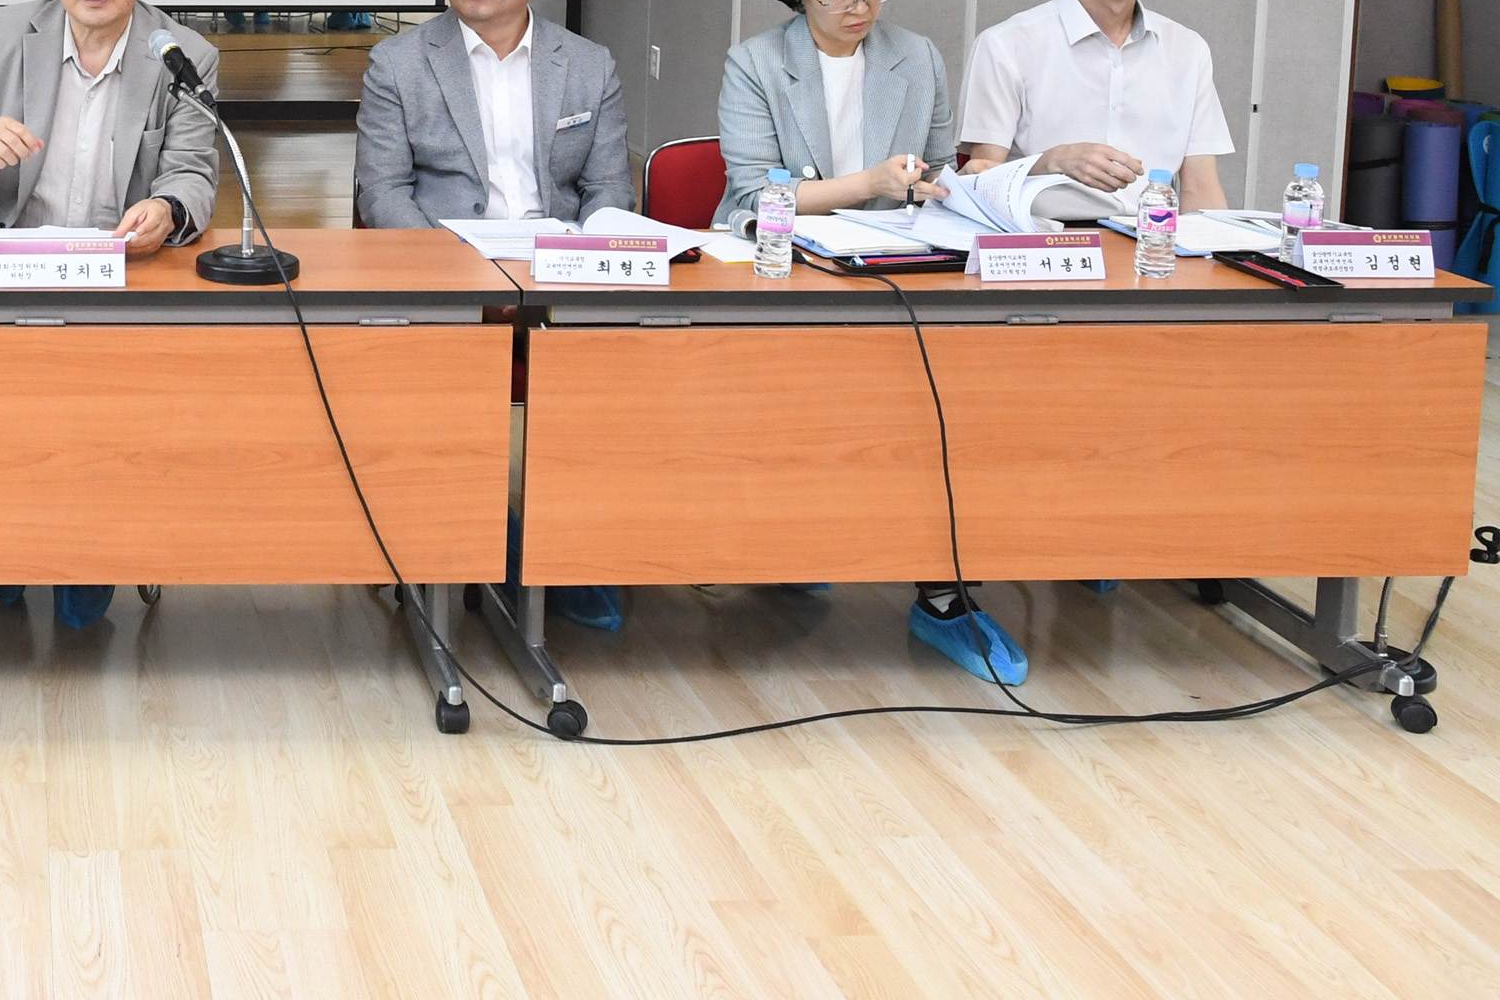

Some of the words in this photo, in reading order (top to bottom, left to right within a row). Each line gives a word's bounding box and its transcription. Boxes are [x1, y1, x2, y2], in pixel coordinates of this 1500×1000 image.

[55, 263, 115, 280] 정치락
[597, 259, 656, 277] 최형근
[1365, 255, 1422, 272] 김정현
